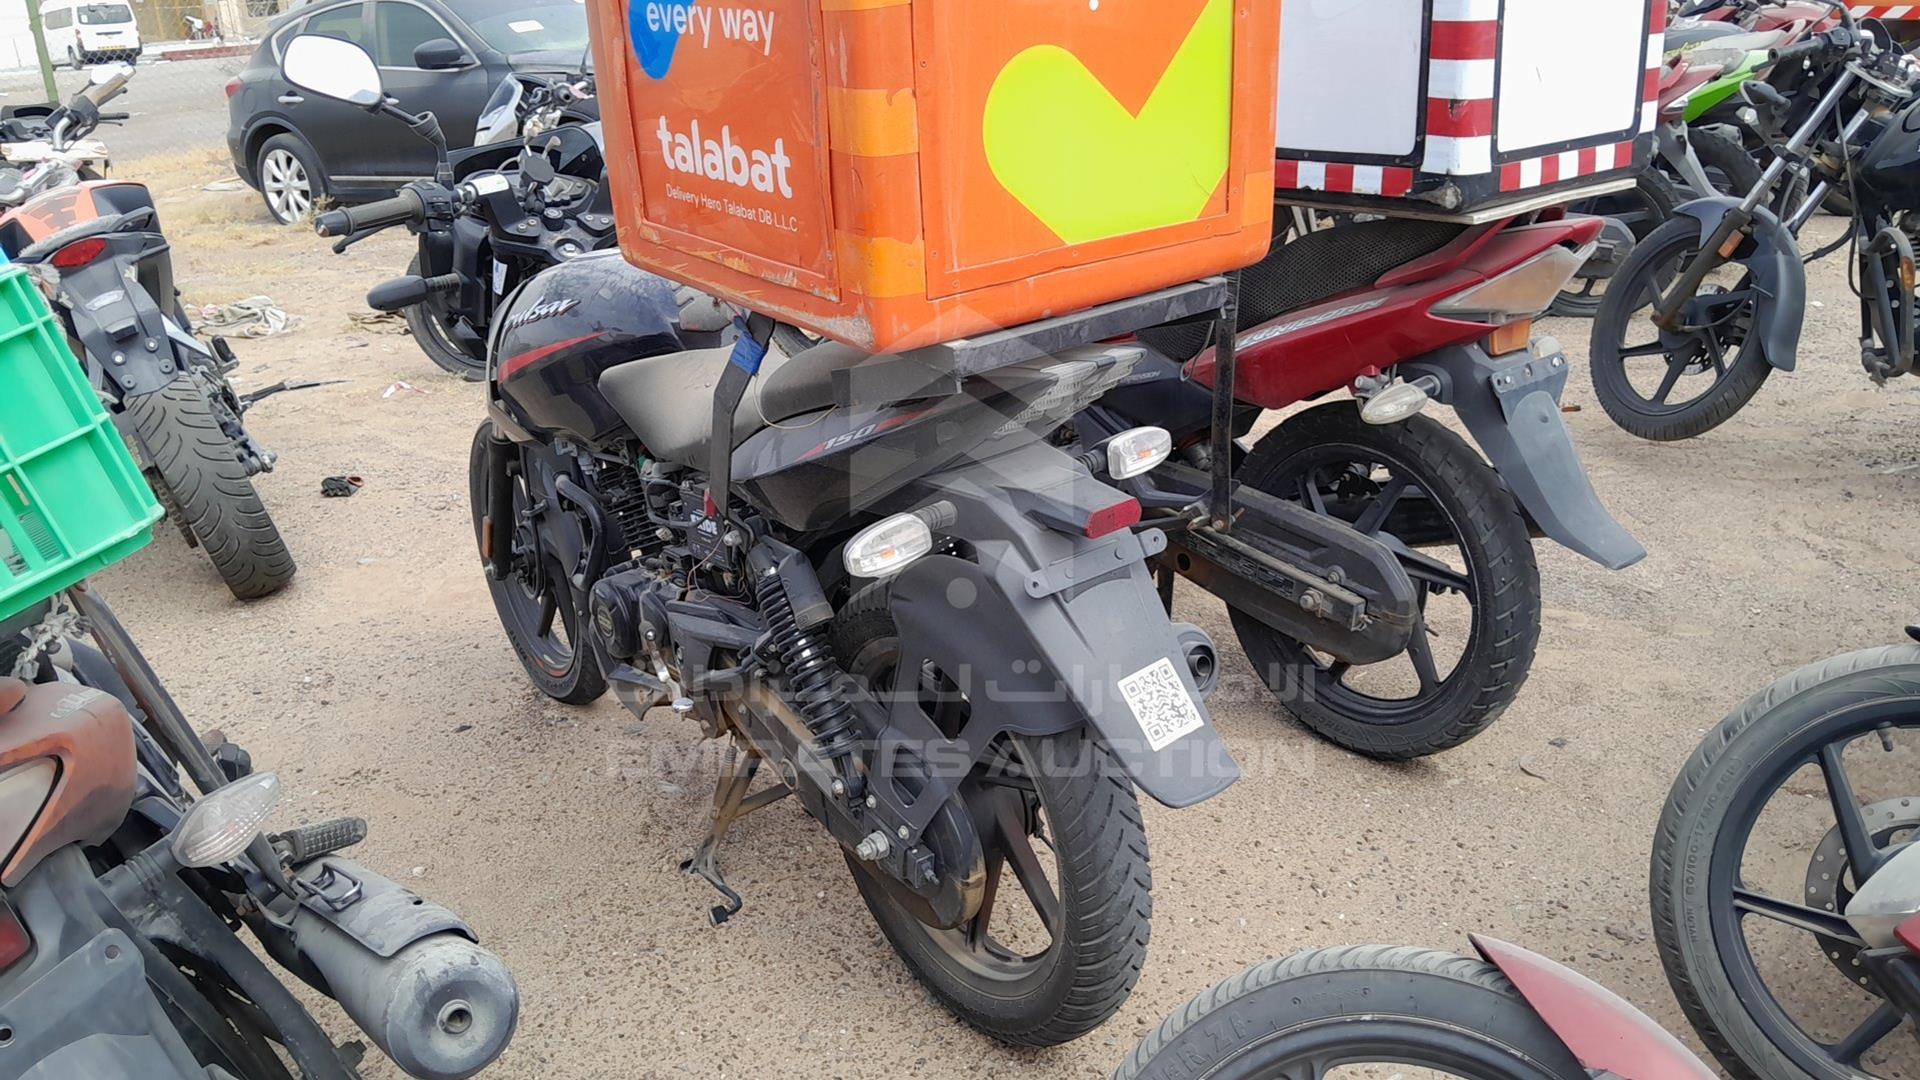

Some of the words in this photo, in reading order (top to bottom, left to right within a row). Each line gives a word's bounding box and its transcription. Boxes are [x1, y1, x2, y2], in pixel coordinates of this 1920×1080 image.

[646, 2, 712, 48] every
[719, 7, 775, 56] way
[656, 115, 793, 199] talabat
[665, 183, 700, 209] Delivery
[700, 192, 722, 212] Hero
[723, 198, 757, 222] Talabat
[758, 207, 773, 226] DB
[823, 423, 877, 450] 150
